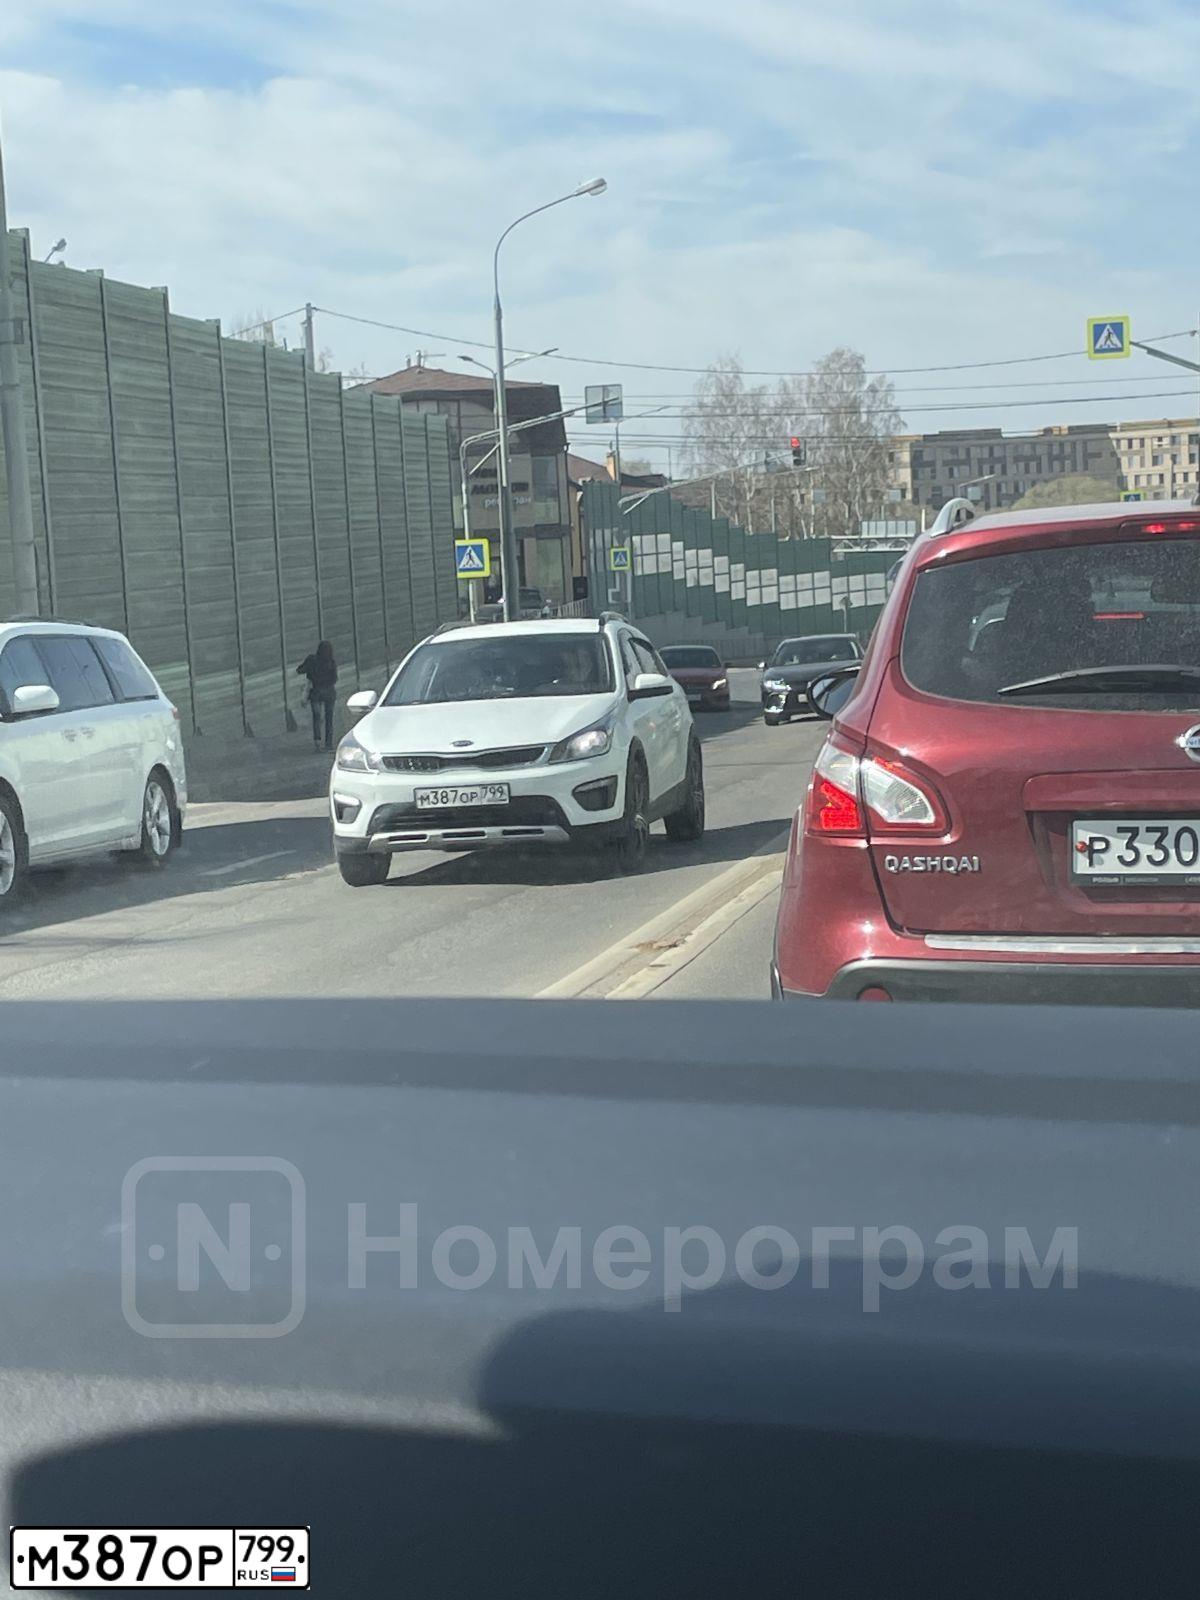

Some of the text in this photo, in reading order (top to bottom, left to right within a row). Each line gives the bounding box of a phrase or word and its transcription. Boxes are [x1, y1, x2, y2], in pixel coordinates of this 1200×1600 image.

[420, 786, 504, 806] М387ОР 799
[885, 855, 980, 873] QASHQAI
